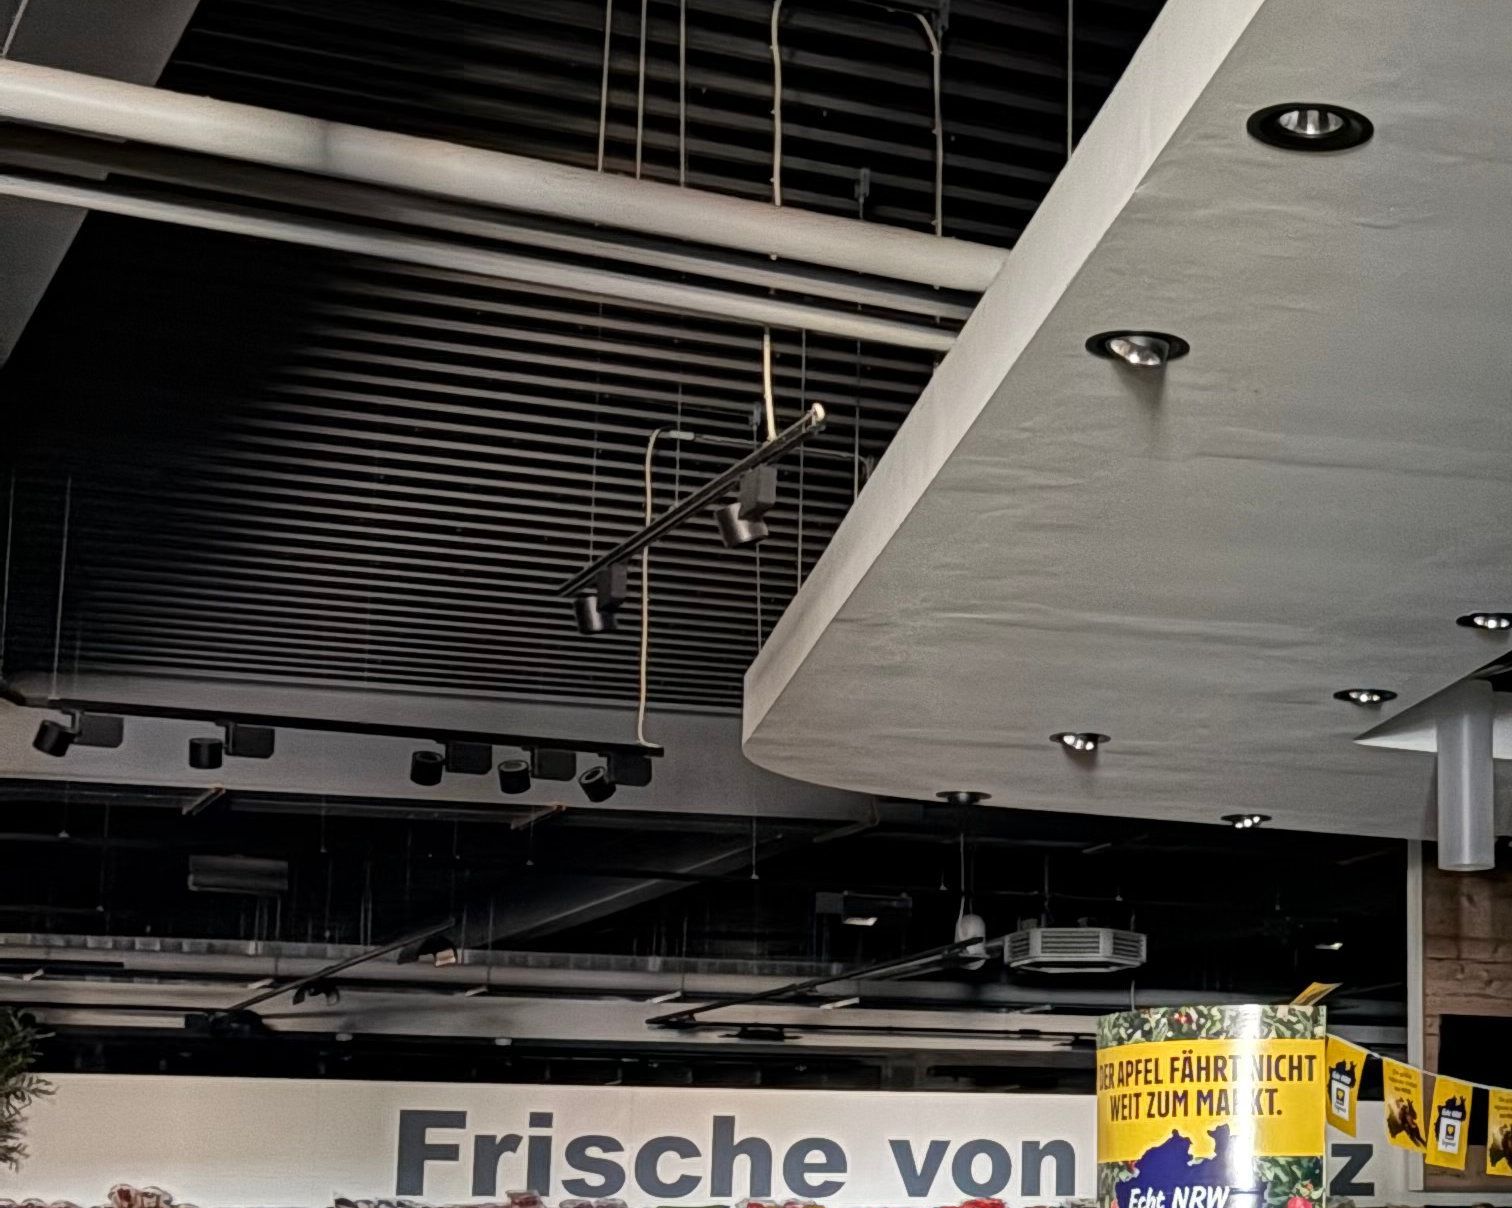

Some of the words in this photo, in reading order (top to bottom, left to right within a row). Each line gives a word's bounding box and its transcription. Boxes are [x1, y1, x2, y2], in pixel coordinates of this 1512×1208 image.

[1117, 1058, 1163, 1087] APFEL
[1170, 1049, 1237, 1083] FÄHRT
[1251, 1054, 1317, 1082] NICHT
[1110, 1092, 1142, 1121] WEIT
[1147, 1089, 1189, 1118] ZUM
[397, 1109, 847, 1198] Frische
[888, 1138, 1076, 1198] von
